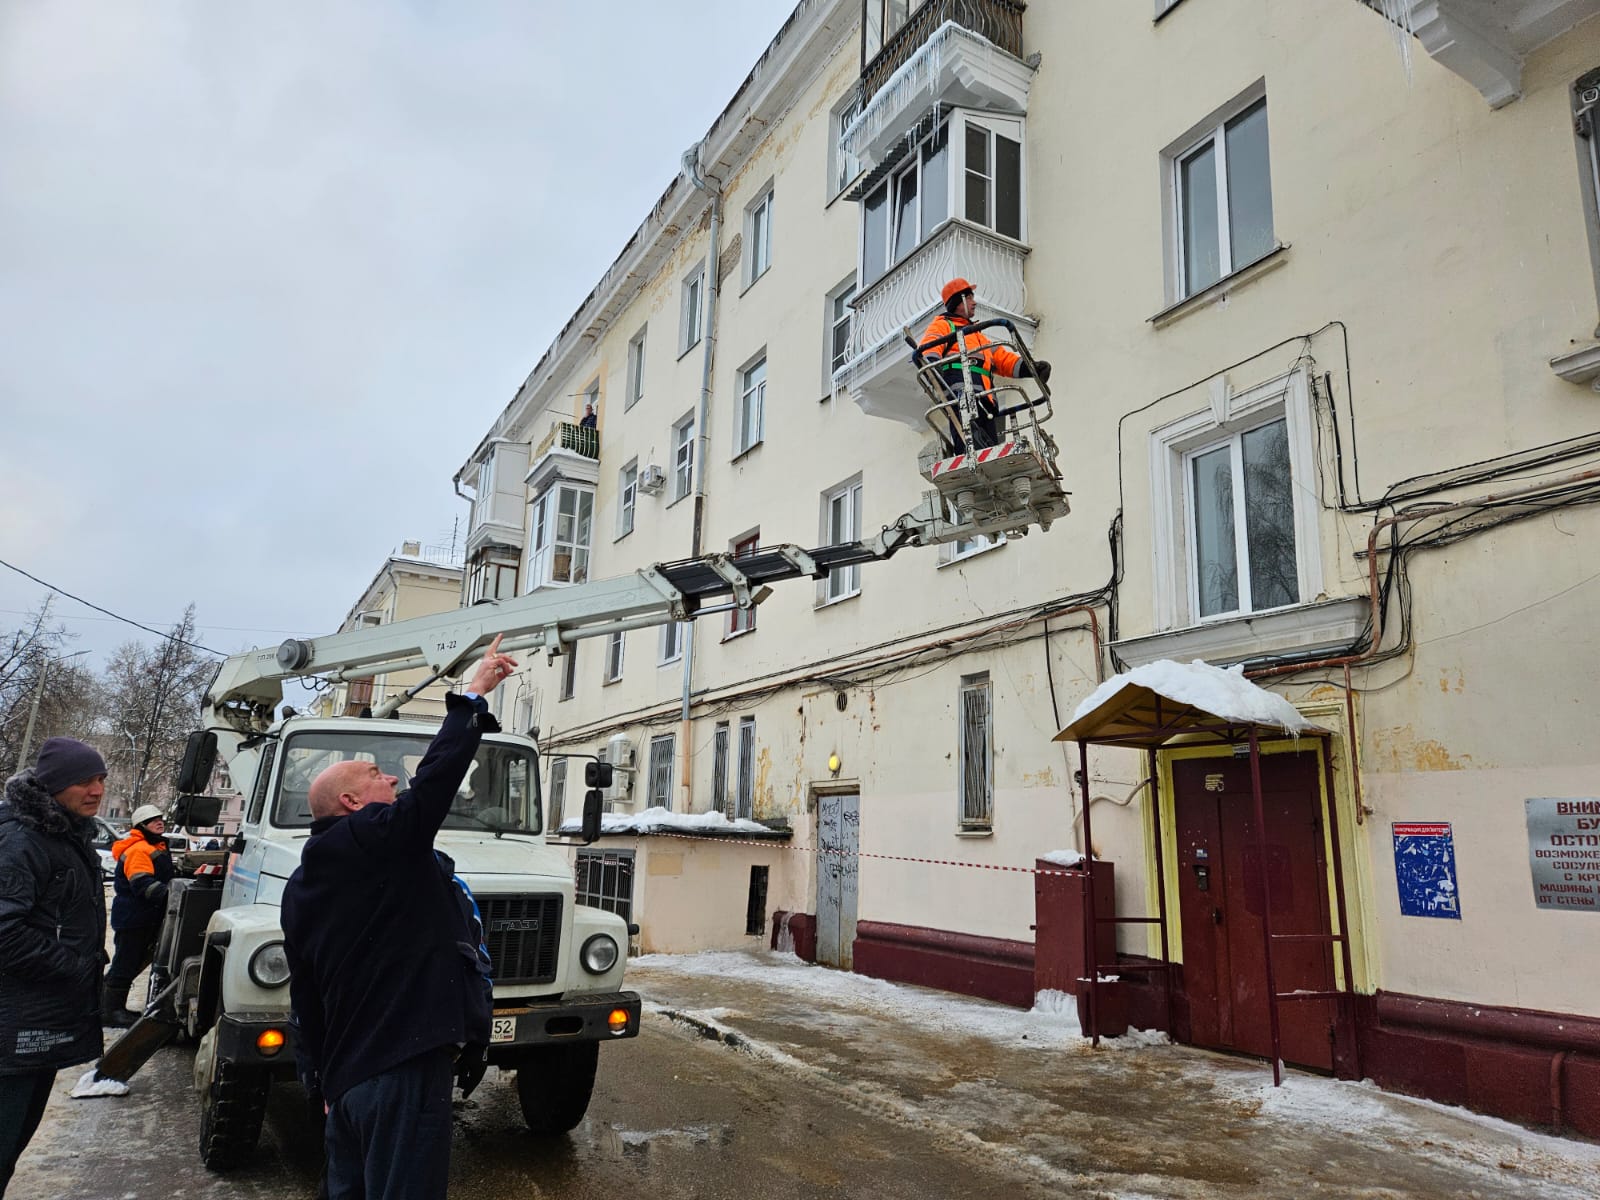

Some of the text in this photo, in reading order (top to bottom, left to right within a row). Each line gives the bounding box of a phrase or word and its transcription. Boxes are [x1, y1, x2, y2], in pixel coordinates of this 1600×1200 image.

[1550, 834, 1600, 846] ОСТО
[1564, 872, 1573, 881] С
[1540, 883, 1593, 893] МАШИНЫ
[1539, 896, 1595, 906] ОТ СТЕНЫ
[491, 919, 539, 931] ГАЗ
[494, 1020, 511, 1034] 52
